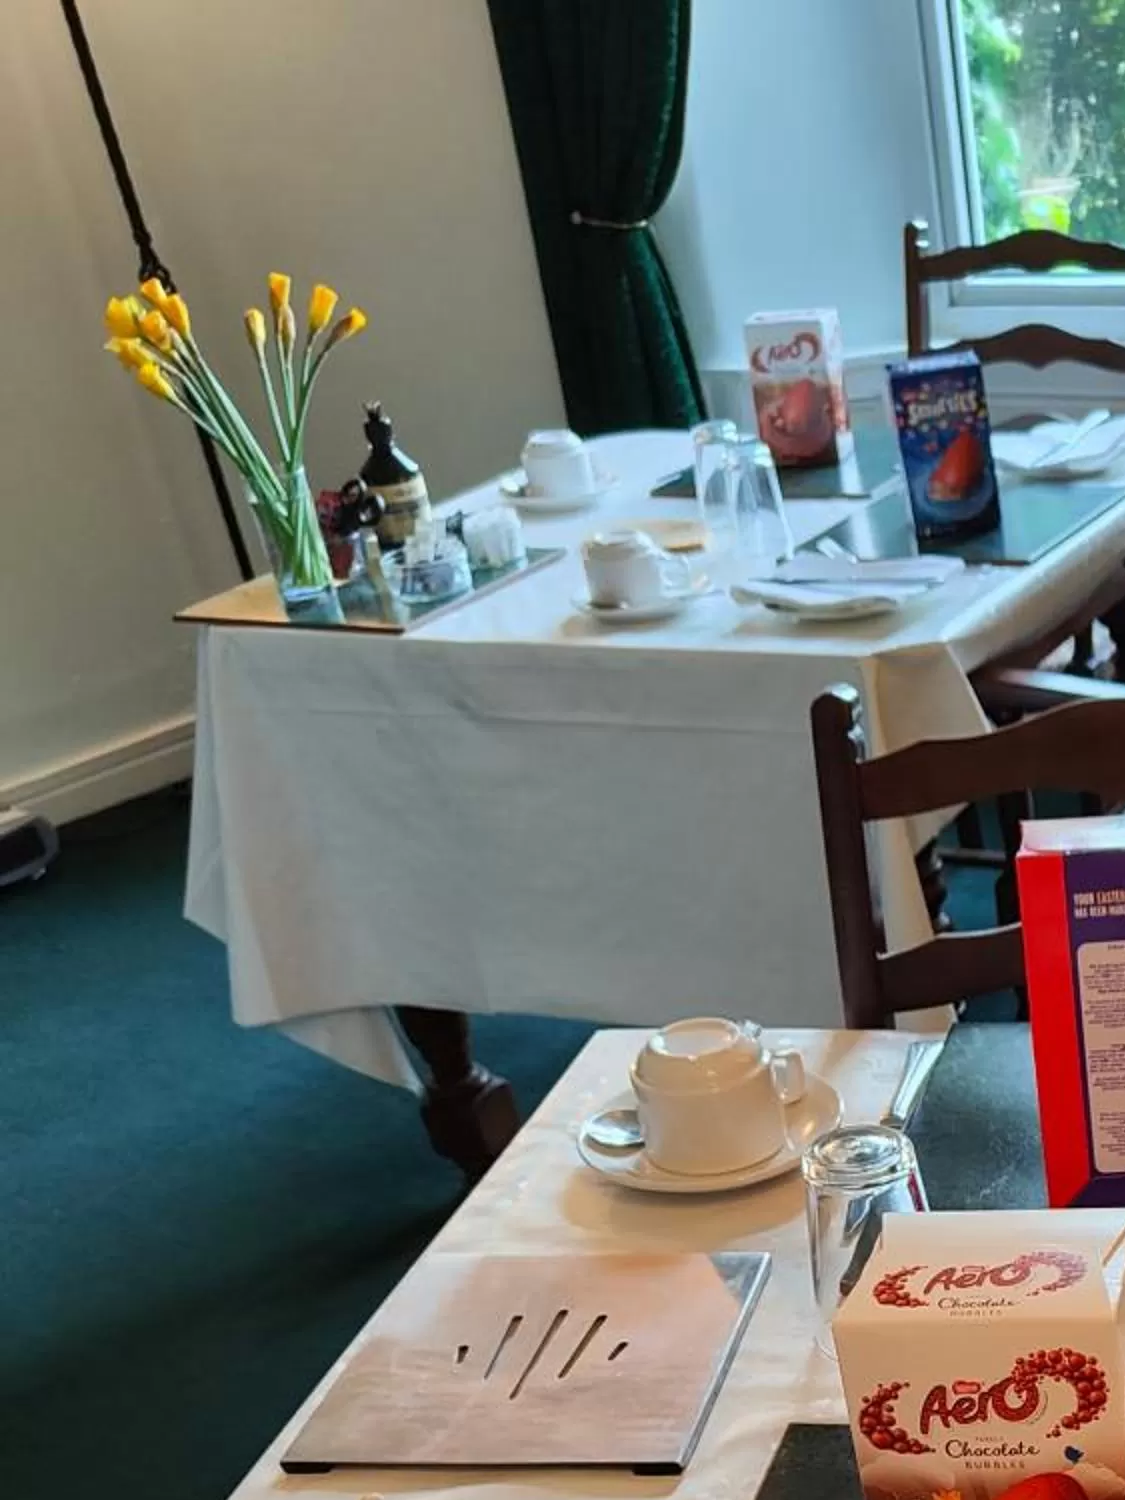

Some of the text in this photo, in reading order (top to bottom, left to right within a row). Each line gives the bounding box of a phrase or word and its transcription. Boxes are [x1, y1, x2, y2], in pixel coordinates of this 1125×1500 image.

[1096, 889, 1125, 904] EASTER
[938, 1296, 1020, 1309] Chocolate
[945, 1439, 1041, 1459] Chocolate
[965, 1460, 1026, 1469] BUBBLES
